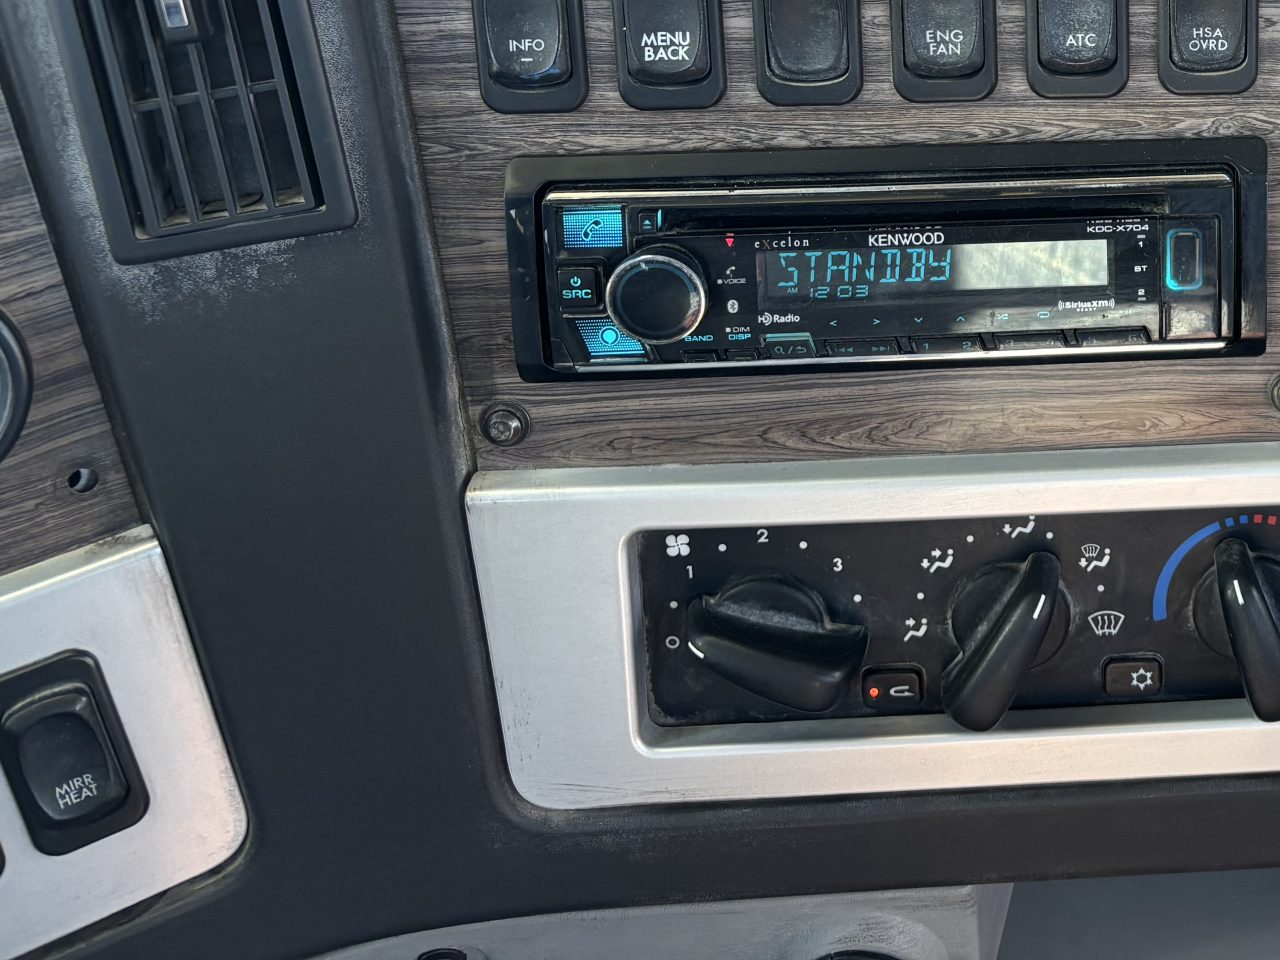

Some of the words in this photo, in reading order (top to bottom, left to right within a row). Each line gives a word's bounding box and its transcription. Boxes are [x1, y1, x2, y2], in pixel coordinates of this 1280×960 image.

[926, 30, 963, 42] ENG
[1194, 27, 1222, 38] HSA
[509, 39, 544, 51] INFO
[641, 32, 690, 46] MENU
[1066, 34, 1096, 47] ATC
[1189, 39, 1227, 51] OVRD
[645, 46, 689, 61] BACK
[930, 43, 960, 55] FAN
[1087, 224, 1149, 233] KDC-X704
[869, 232, 944, 247] KENWOOD
[778, 248, 952, 287] STANDBY
[563, 290, 591, 298] SRC
[774, 314, 800, 323] Radio
[684, 334, 713, 342] BAND
[728, 333, 751, 341] DISP
[757, 529, 768, 542] 2
[833, 558, 842, 571] 3
[687, 566, 692, 578] 1
[55, 773, 94, 799] MIRR
[57, 783, 98, 810] HEAT
